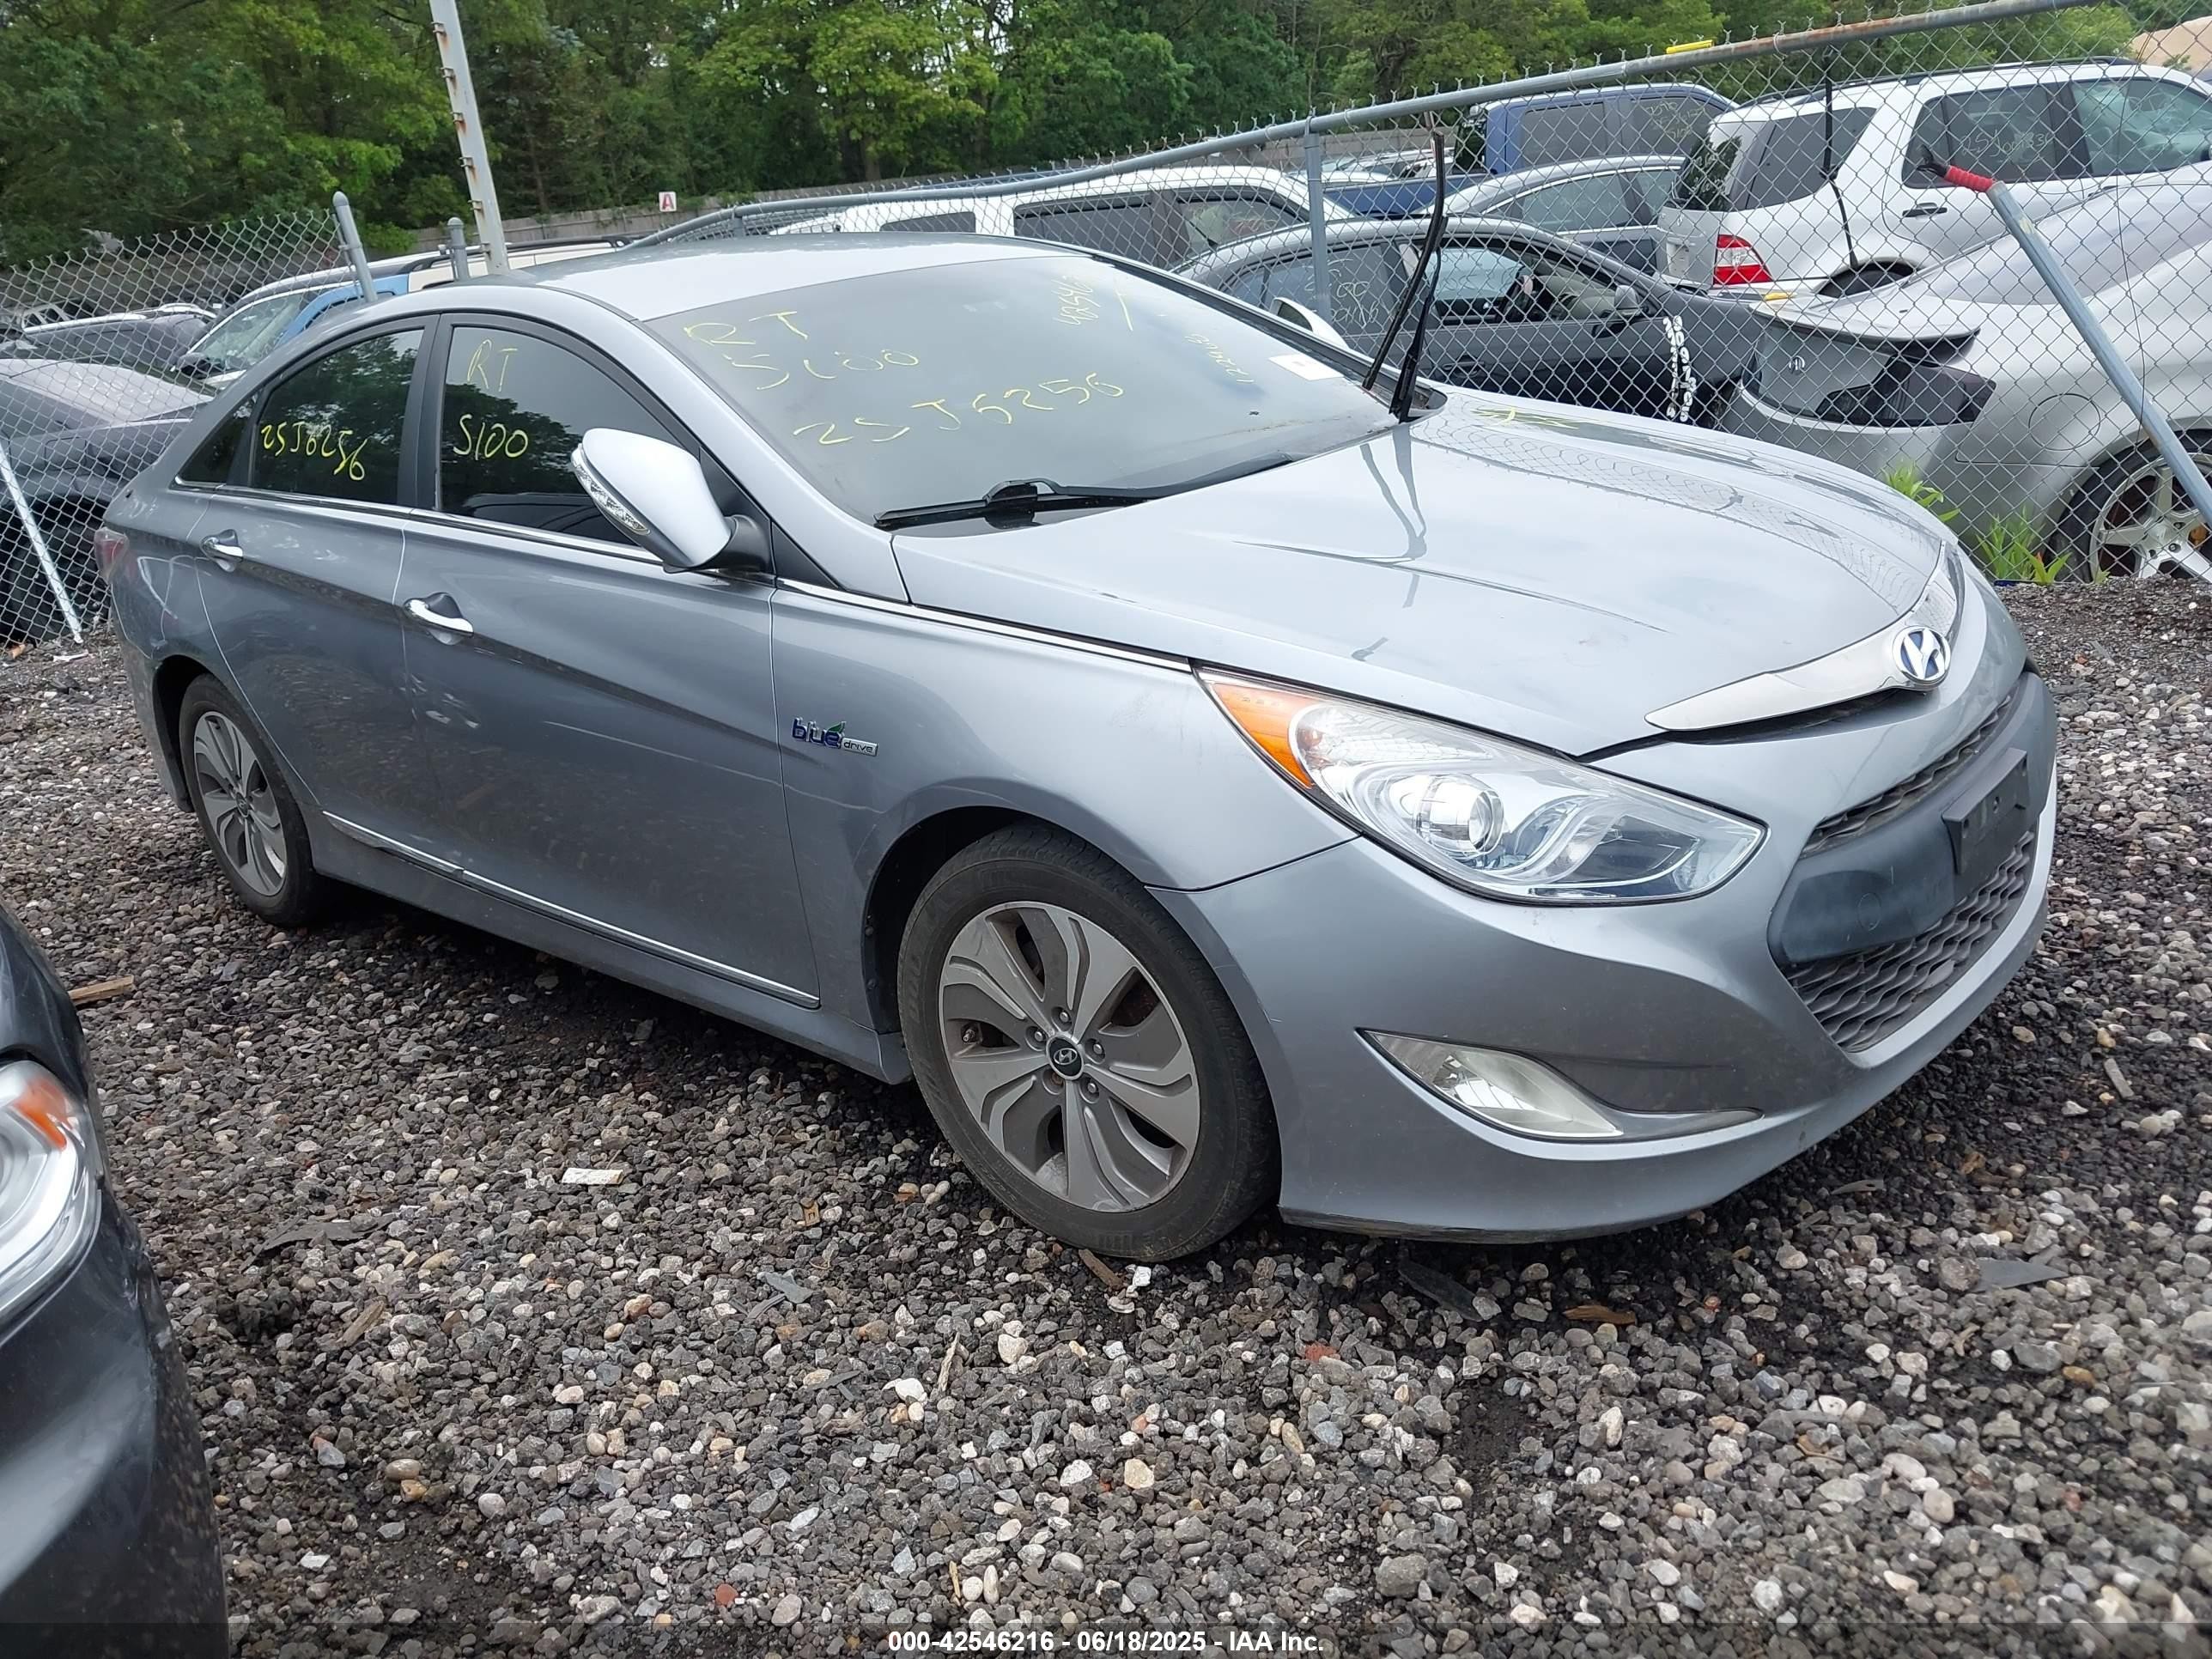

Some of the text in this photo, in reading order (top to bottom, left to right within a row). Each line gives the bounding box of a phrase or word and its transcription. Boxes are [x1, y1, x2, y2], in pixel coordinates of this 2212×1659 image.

[661, 193, 675, 210] A
[466, 338, 518, 392] RT
[792, 716, 874, 753] blue drive
